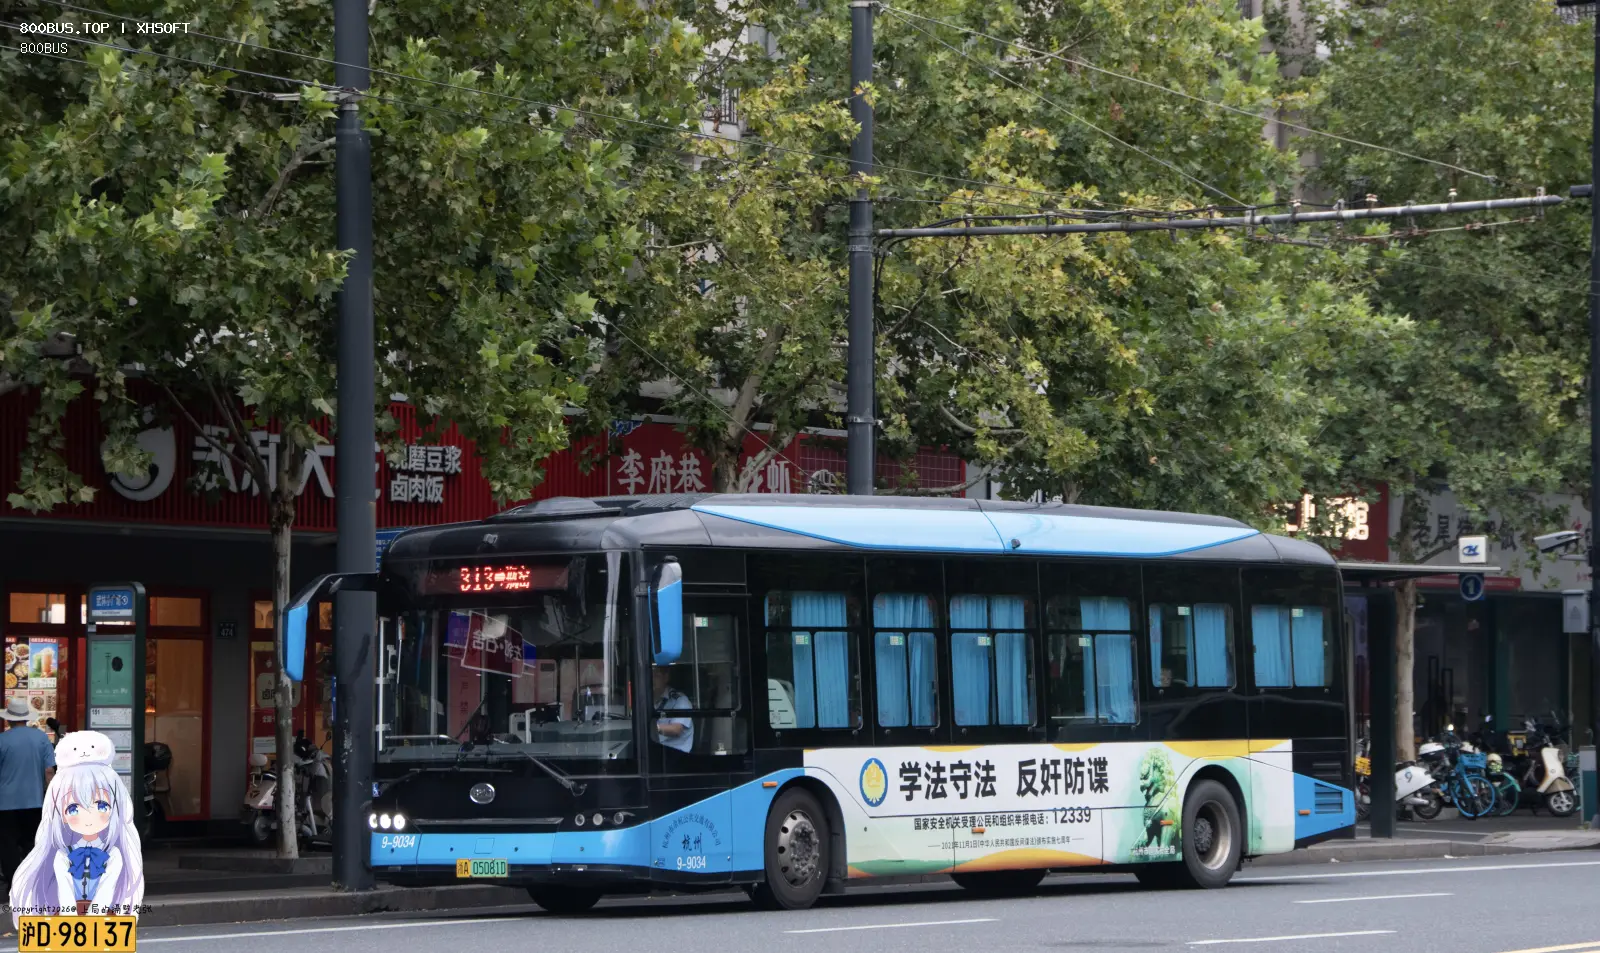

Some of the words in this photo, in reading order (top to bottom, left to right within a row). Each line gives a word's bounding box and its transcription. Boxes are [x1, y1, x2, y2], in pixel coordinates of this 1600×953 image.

[617, 447, 706, 495] 李府巷
[391, 473, 444, 503] 卤肉饭
[899, 760, 997, 802] 学法守法
[1016, 756, 1109, 798] 反奸防谍
[1052, 806, 1092, 825] 12339
[381, 834, 416, 850] 9-9034
[681, 832, 703, 855] 杭州
[676, 855, 707, 870] 9-9034
